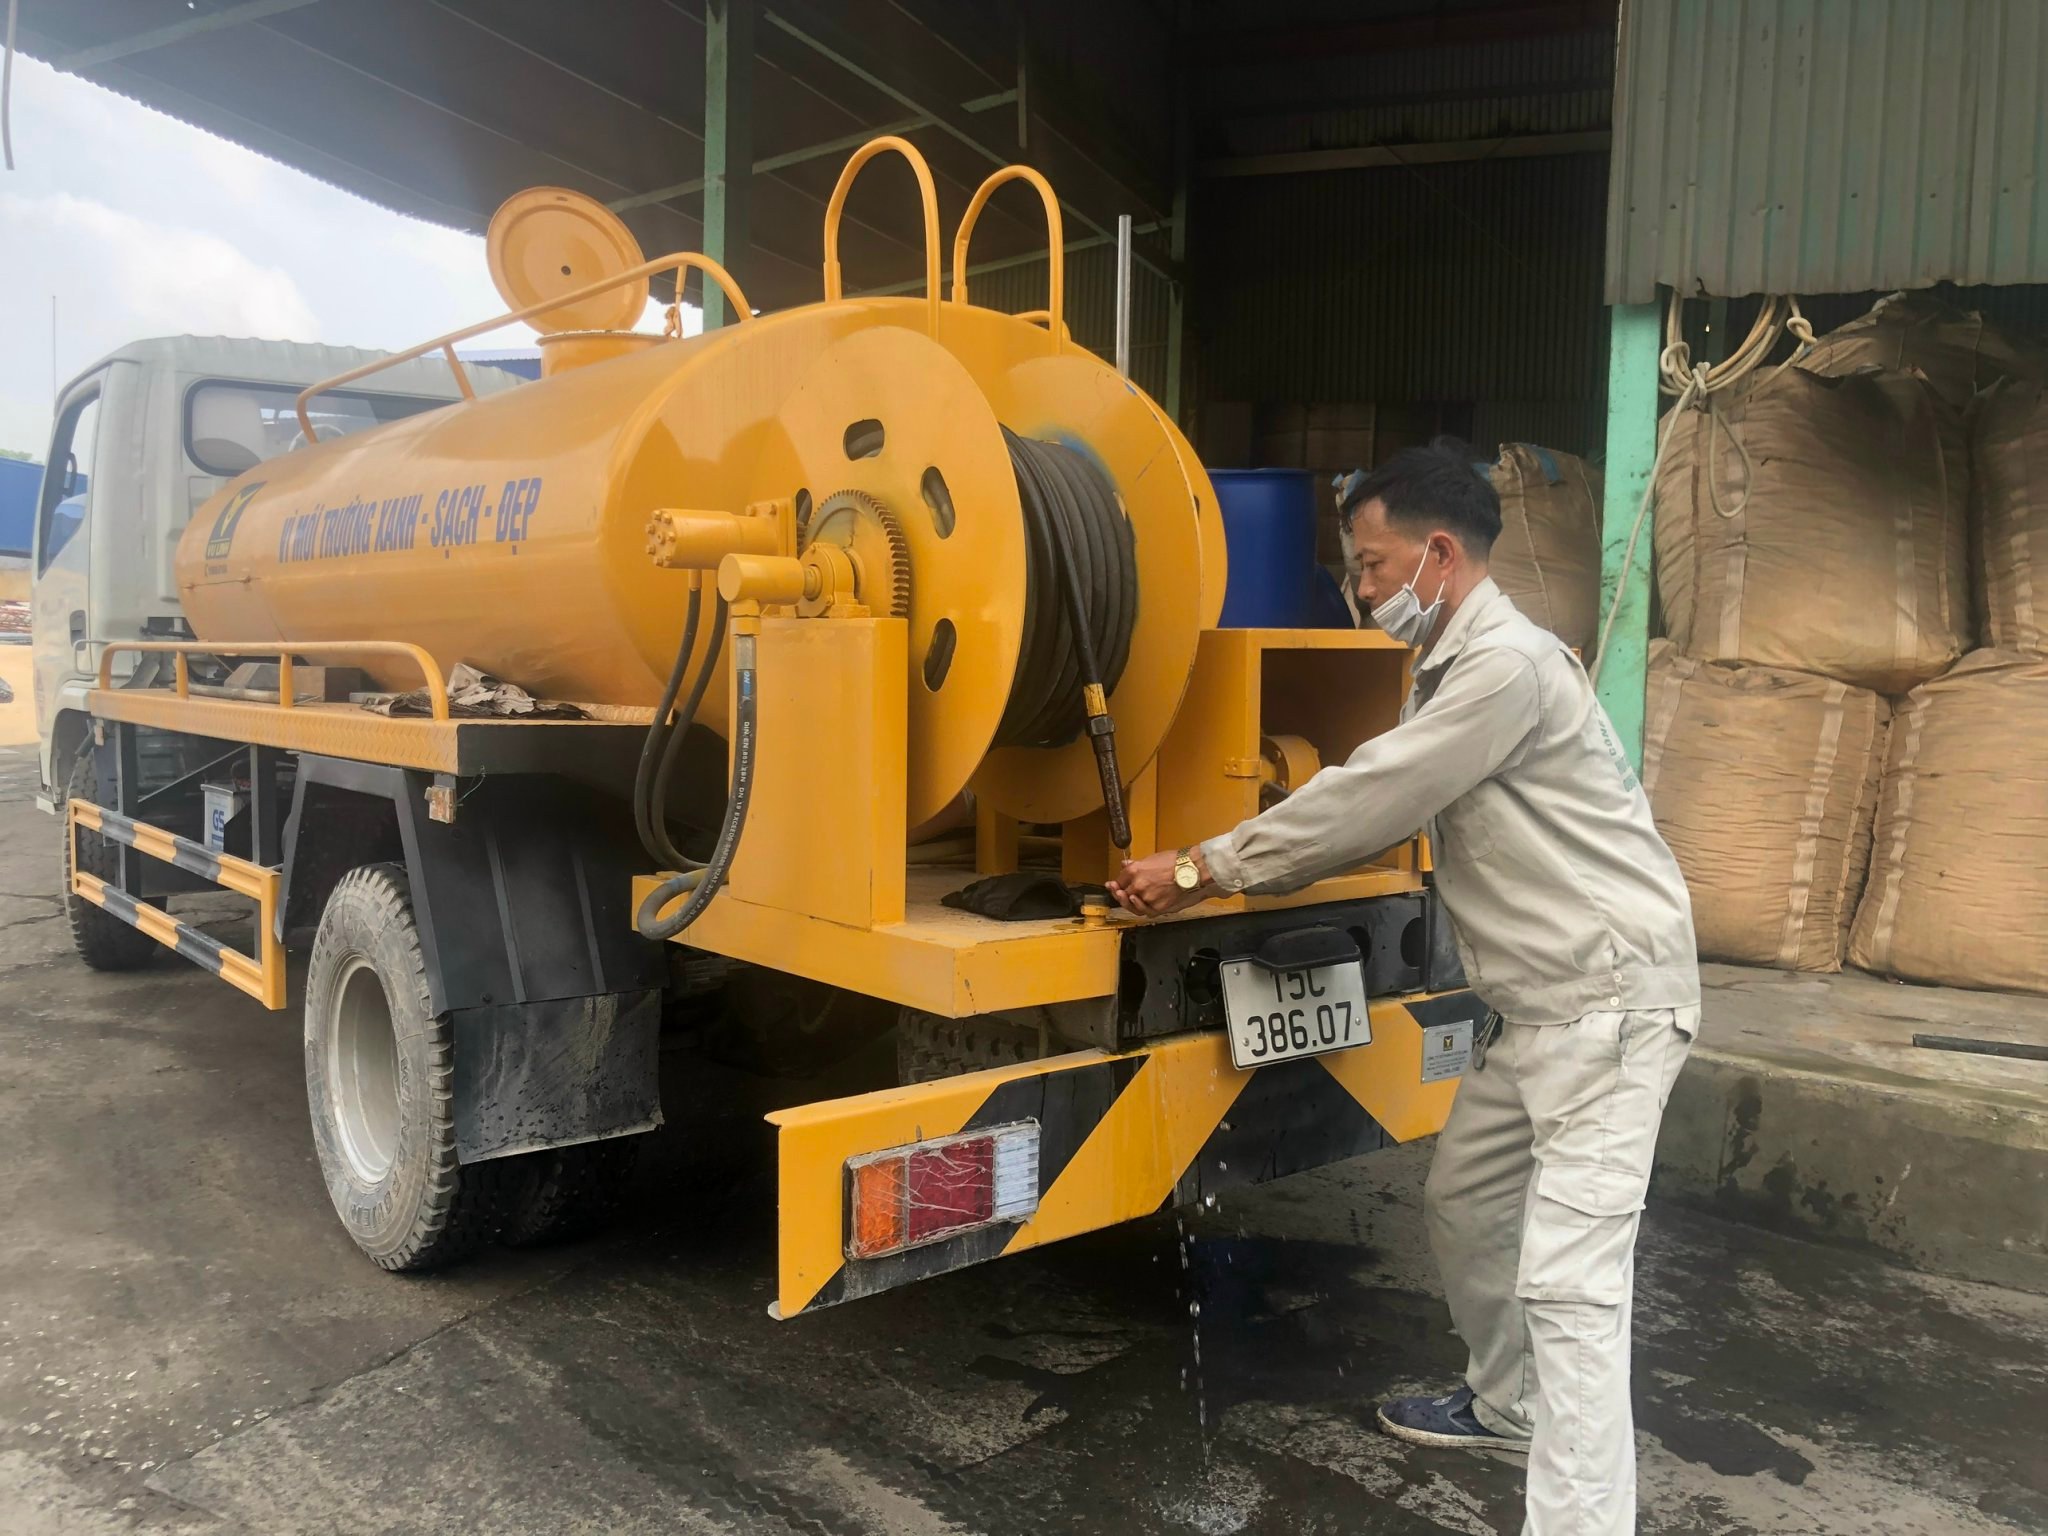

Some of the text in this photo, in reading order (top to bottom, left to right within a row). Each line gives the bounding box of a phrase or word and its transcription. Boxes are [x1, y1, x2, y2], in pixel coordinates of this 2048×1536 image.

[319, 494, 378, 560] TRƯỜNG
[373, 493, 423, 553] XANH
[430, 484, 487, 560] SẠCH
[495, 477, 542, 556] ĐẸP
[743, 721, 751, 735] DIN
[743, 737, 750, 749] EN
[737, 787, 745, 799] DN
[212, 808, 225, 832] GS
[1268, 967, 1326, 1003] 15C
[1247, 1001, 1352, 1057] 386.07
